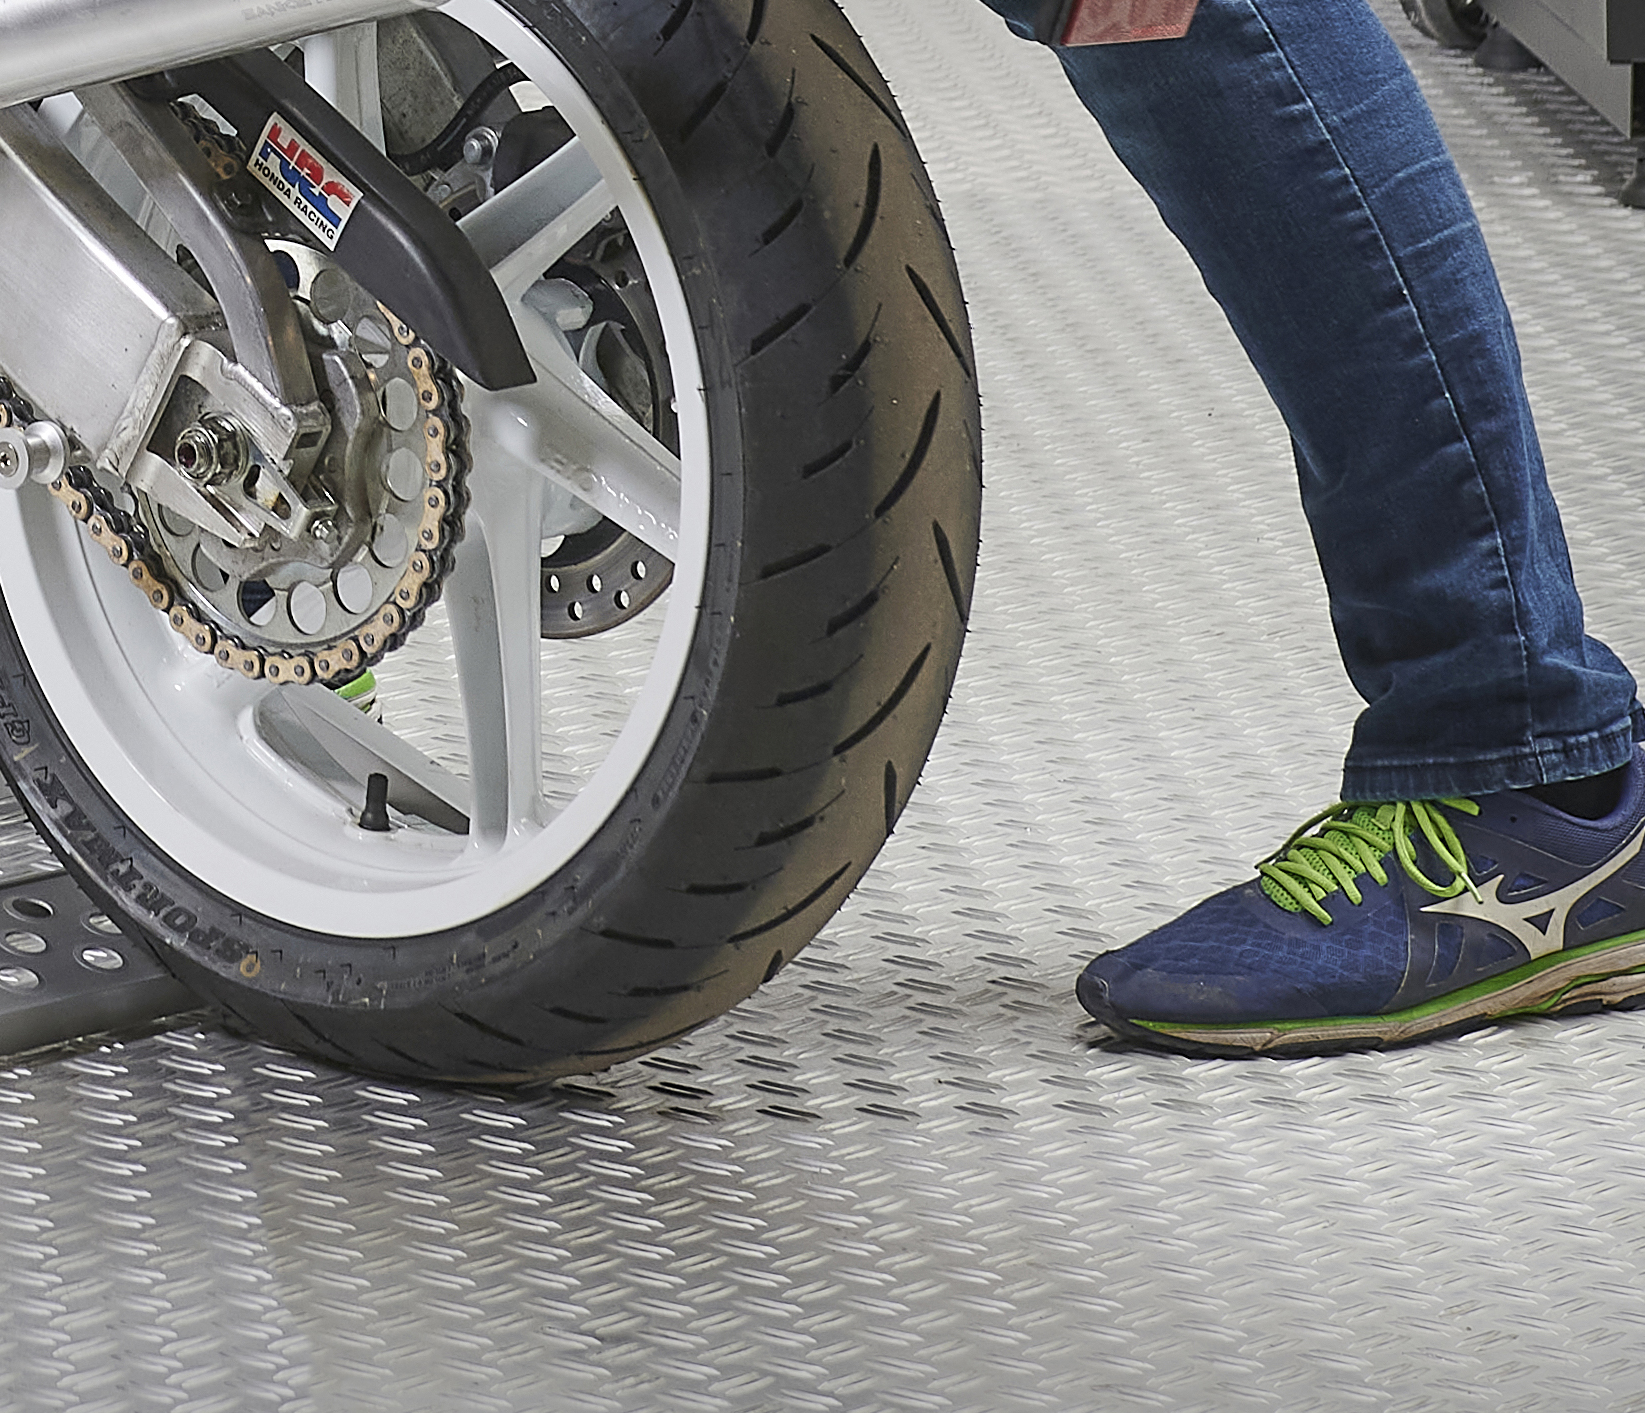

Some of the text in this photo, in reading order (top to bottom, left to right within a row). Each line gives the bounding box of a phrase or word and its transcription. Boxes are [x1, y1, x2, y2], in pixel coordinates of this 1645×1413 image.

[254, 158, 336, 241] HONDA RACING
[260, 122, 356, 230] HRC
[32, 771, 254, 965] SPORTMAX
